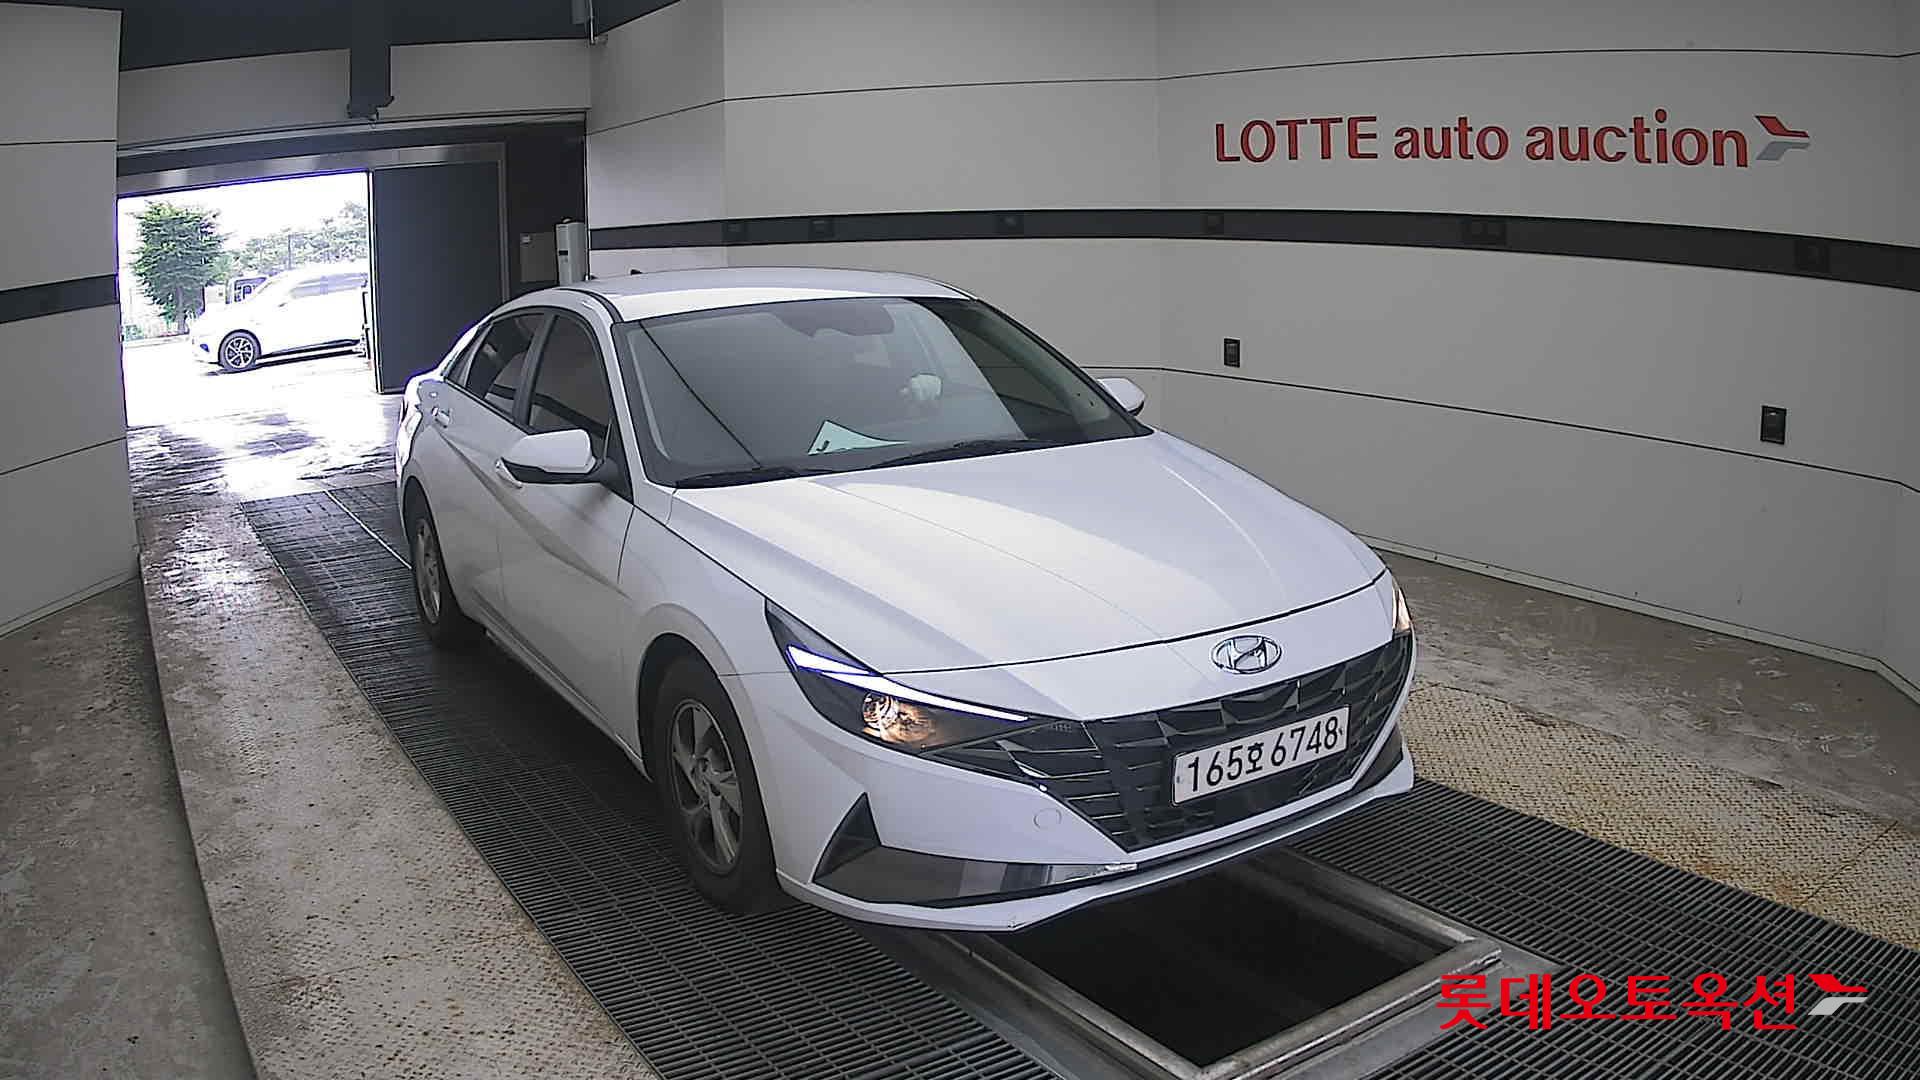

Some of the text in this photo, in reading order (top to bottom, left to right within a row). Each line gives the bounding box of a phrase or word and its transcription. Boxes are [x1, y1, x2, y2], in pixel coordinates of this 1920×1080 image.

[1215, 109, 1749, 167] LOTTE auto auction
[1187, 716, 1338, 792] 165호 6748
